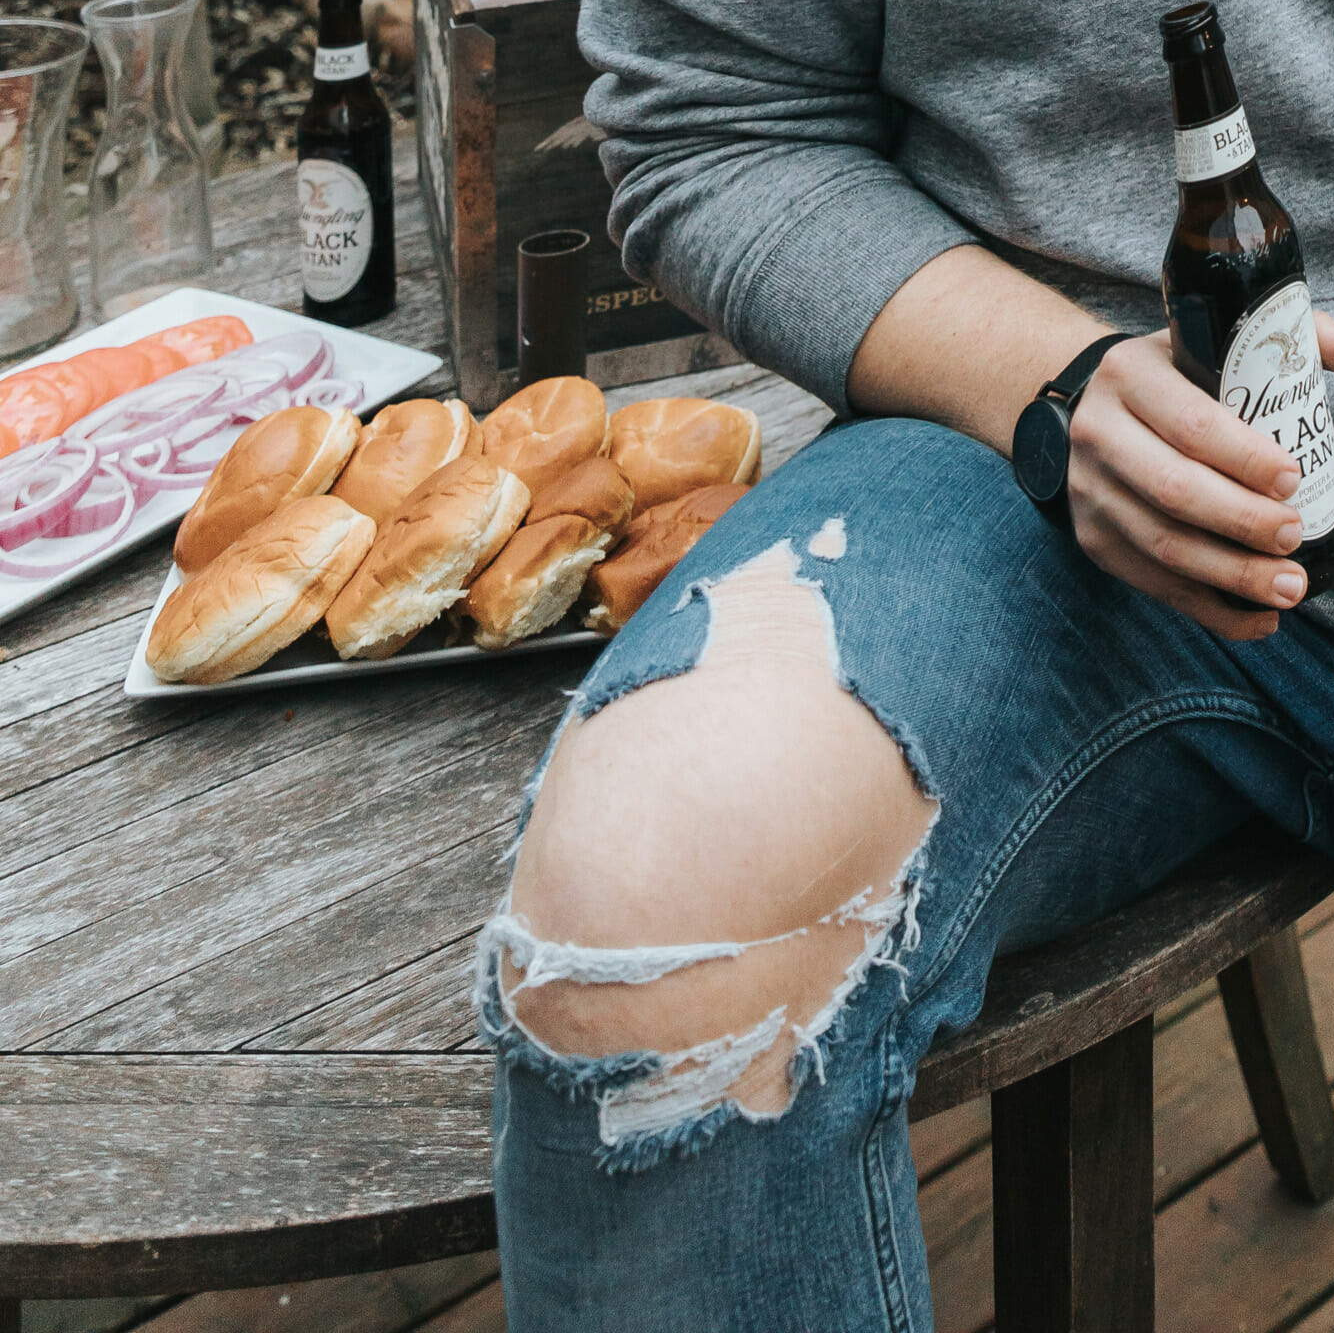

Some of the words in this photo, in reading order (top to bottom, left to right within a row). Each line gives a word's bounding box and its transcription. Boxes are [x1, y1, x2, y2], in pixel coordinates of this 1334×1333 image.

[1213, 116, 1249, 151] BLAC
[303, 230, 358, 250] LACK
[587, 287, 665, 315] SPEC
[1272, 395, 1331, 454] LAC
[1294, 487, 1325, 510] REMIUM
